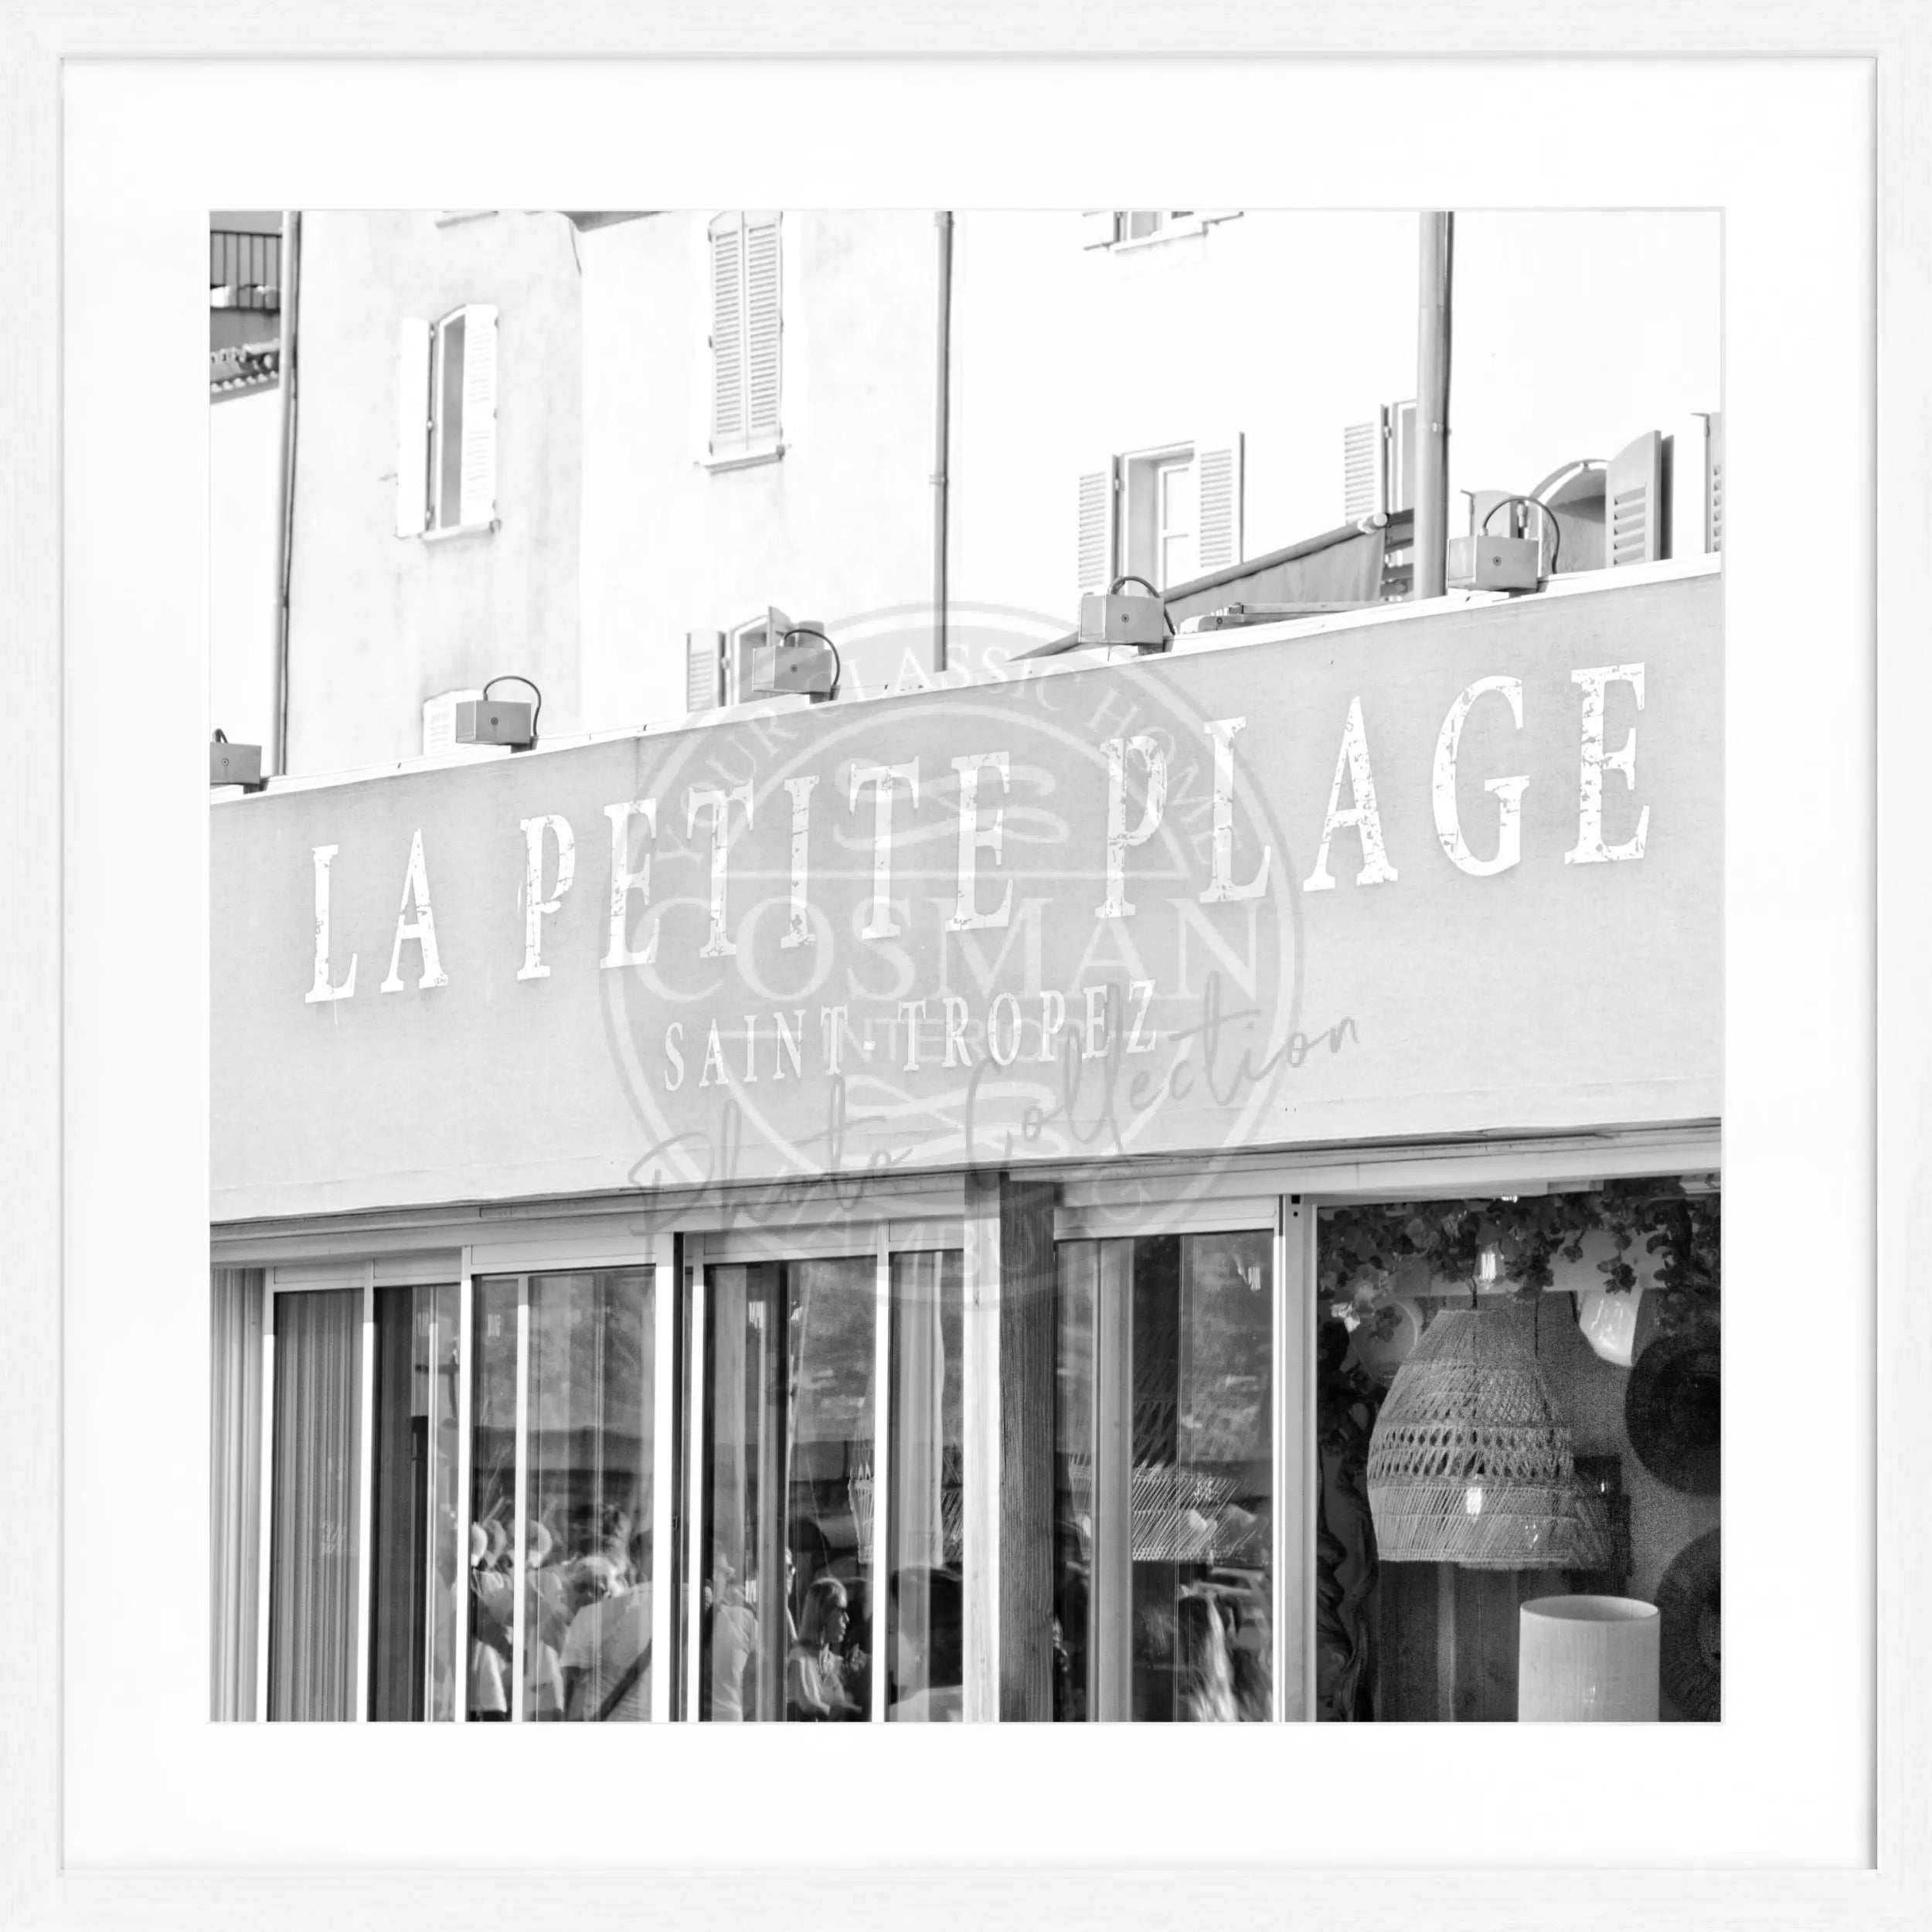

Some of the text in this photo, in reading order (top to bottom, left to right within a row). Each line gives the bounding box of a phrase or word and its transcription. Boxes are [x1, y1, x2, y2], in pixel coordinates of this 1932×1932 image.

[304, 662, 1650, 1003] LA PETITE PLAGE
